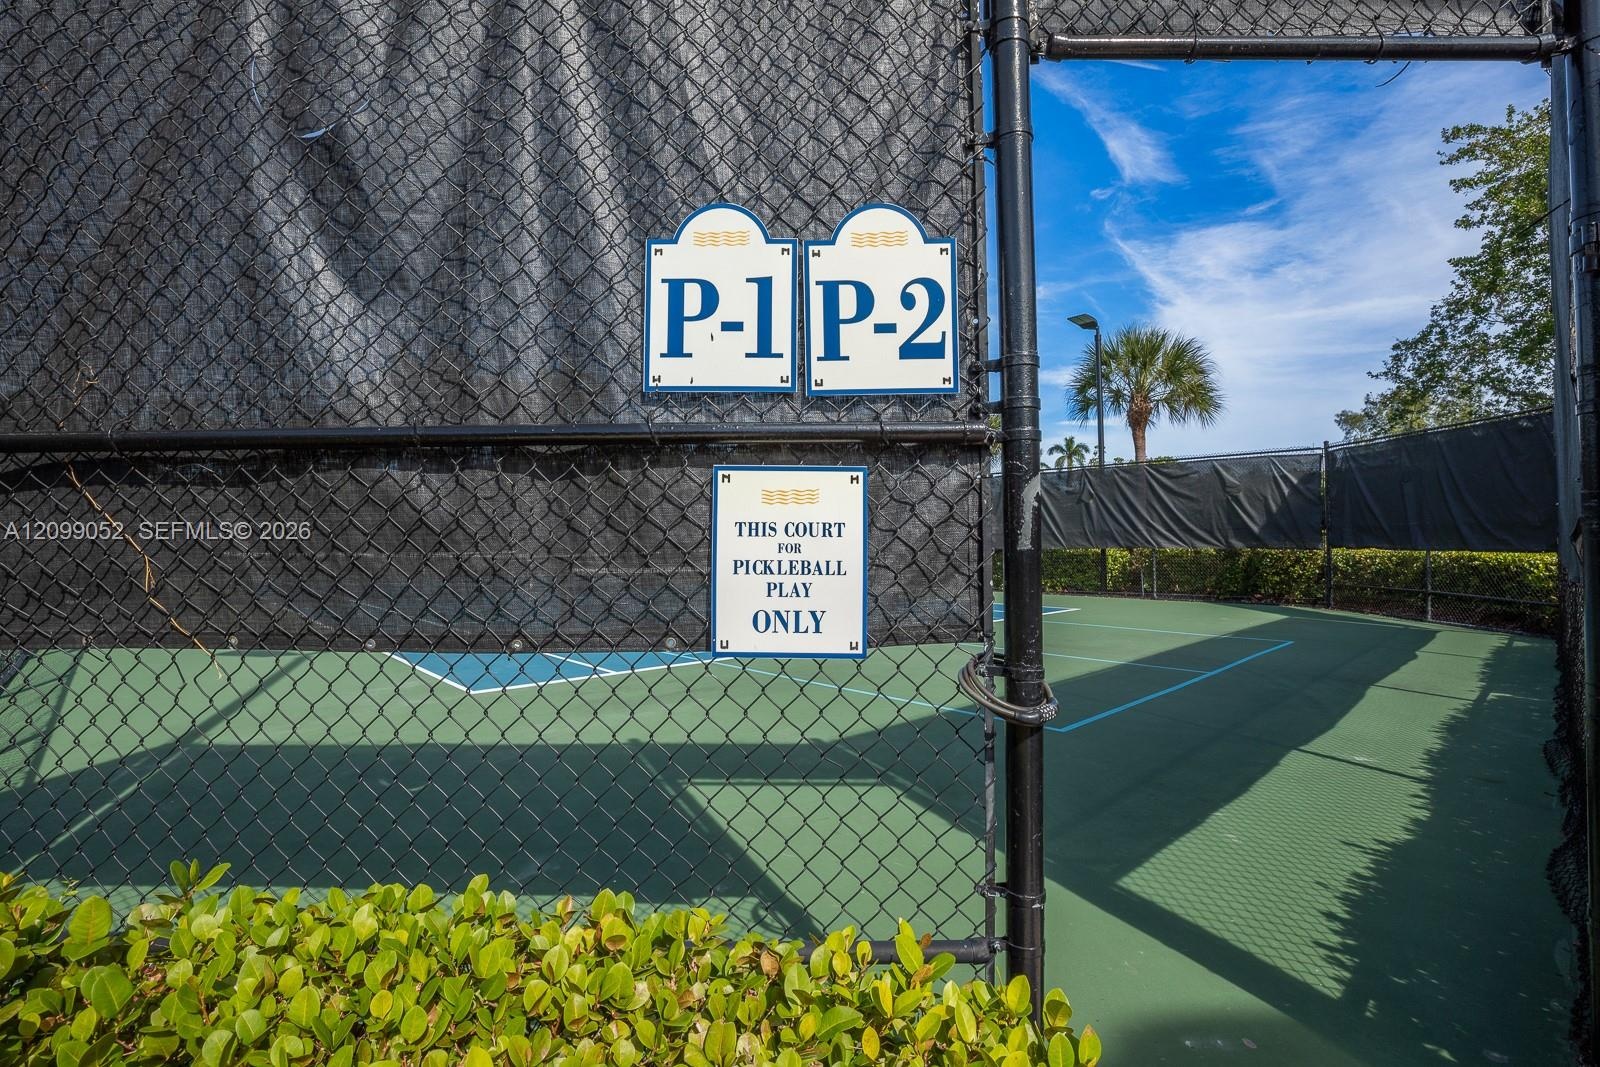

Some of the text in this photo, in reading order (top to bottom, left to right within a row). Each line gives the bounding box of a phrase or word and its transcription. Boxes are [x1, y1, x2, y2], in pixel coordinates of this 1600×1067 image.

[659, 275, 784, 359] P-1
[815, 277, 947, 362] P-2
[734, 521, 846, 538] THIS COURT
[777, 542, 802, 554] FOR
[732, 559, 847, 576] PICKLEBALL
[766, 582, 813, 598] PLAY
[752, 609, 826, 634] ONLY
